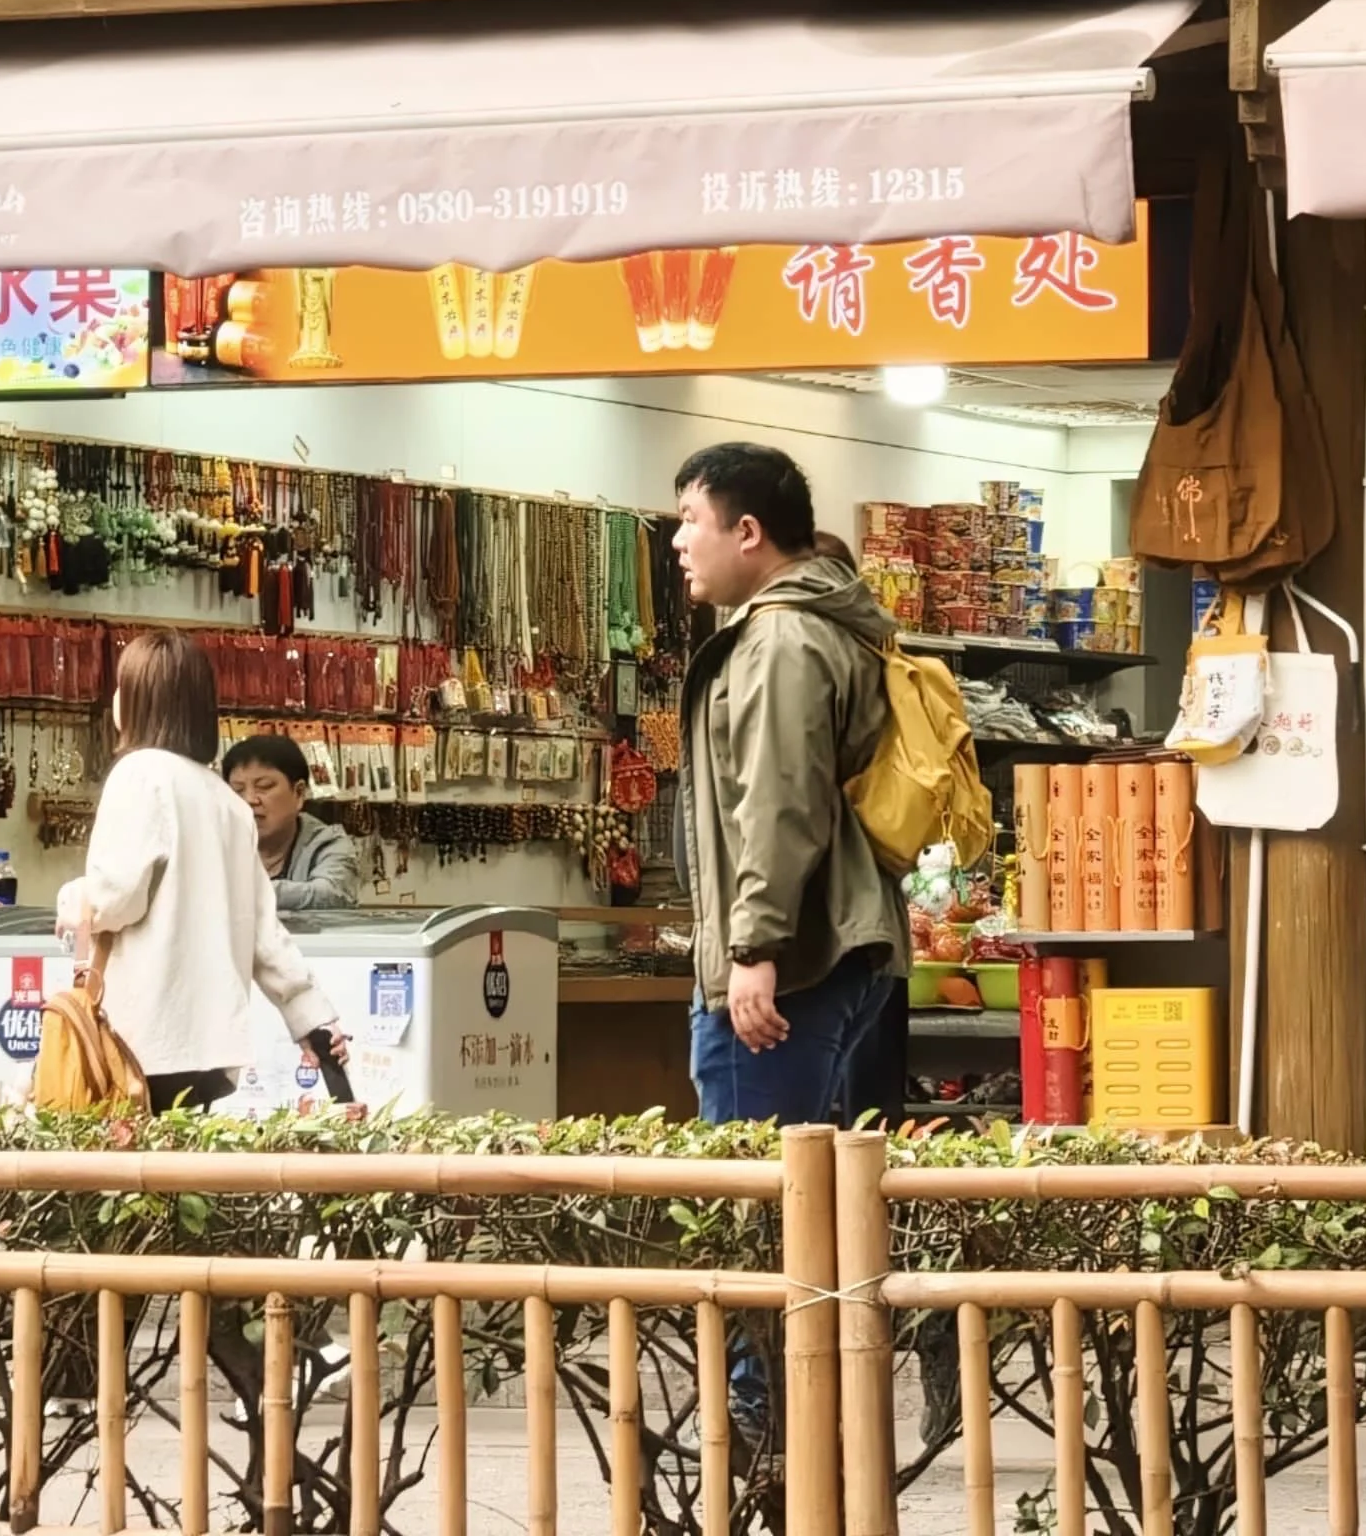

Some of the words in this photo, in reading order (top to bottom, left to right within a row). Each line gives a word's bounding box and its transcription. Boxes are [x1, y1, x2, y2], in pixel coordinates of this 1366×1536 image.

[783, 230, 1118, 336] 请香处
[7, 1039, 40, 1051] UBES
